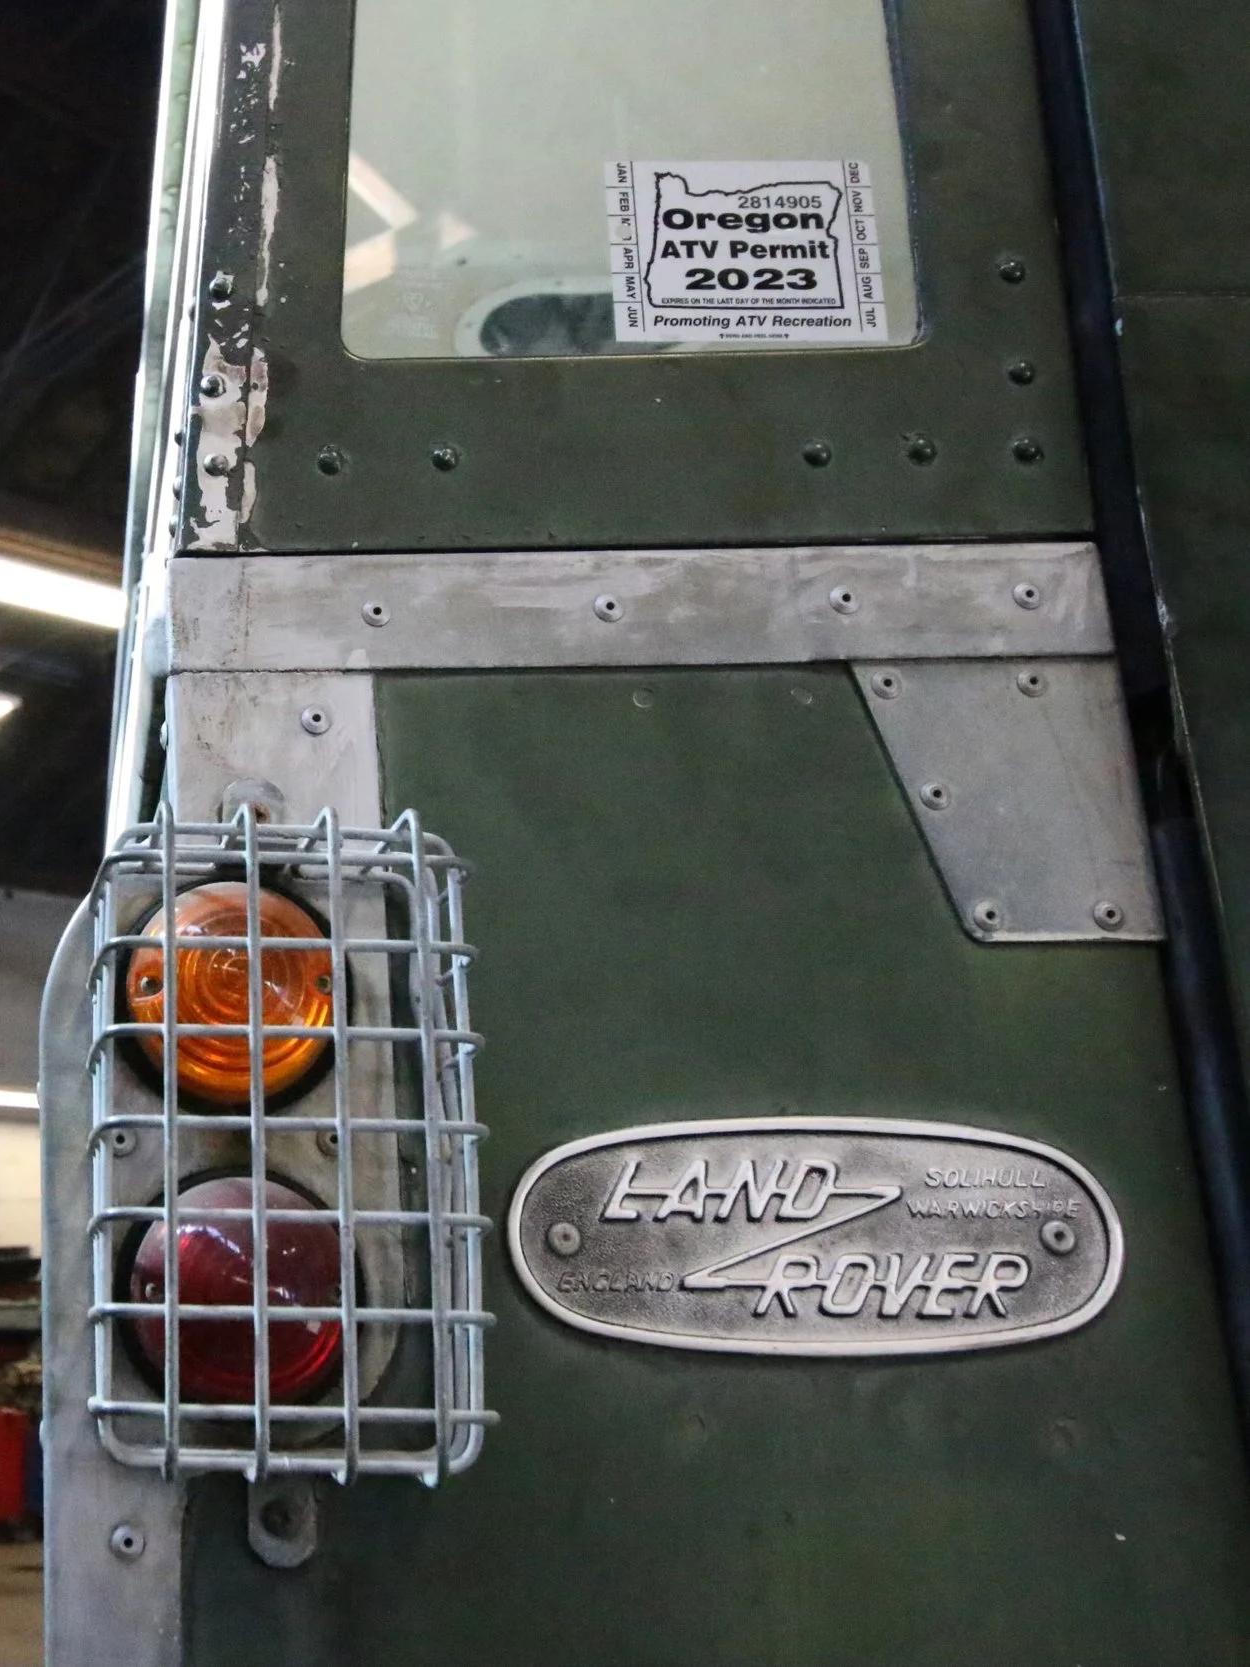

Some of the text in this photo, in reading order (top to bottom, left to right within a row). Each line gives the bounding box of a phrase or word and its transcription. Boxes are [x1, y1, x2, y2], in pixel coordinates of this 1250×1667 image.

[617, 163, 627, 183] JAN
[848, 162, 859, 183] DEC
[619, 191, 629, 212] FEB
[738, 196, 822, 209] 2814905
[852, 191, 863, 212] NOV
[662, 208, 824, 233] Oregon
[855, 219, 866, 241] OCT
[624, 247, 634, 269] APR
[661, 240, 830, 259] ATV Permit
[858, 247, 869, 269] SEP
[625, 276, 636, 299] MAY
[685, 268, 817, 290] 2023
[863, 276, 873, 299] AUG
[661, 297, 837, 305] EXPIRES ON THE LAST DAY OF THE MONTH INDICATED
[628, 306, 638, 328] JUN
[654, 314, 852, 329] Promoting ATV Recreation
[865, 307, 876, 328] JUL
[925, 1168, 1047, 1189] SOLIHULL
[601, 1160, 840, 1222] LAND
[555, 1270, 675, 1293] ENGLAND
[752, 1253, 1031, 1318] ROVER
